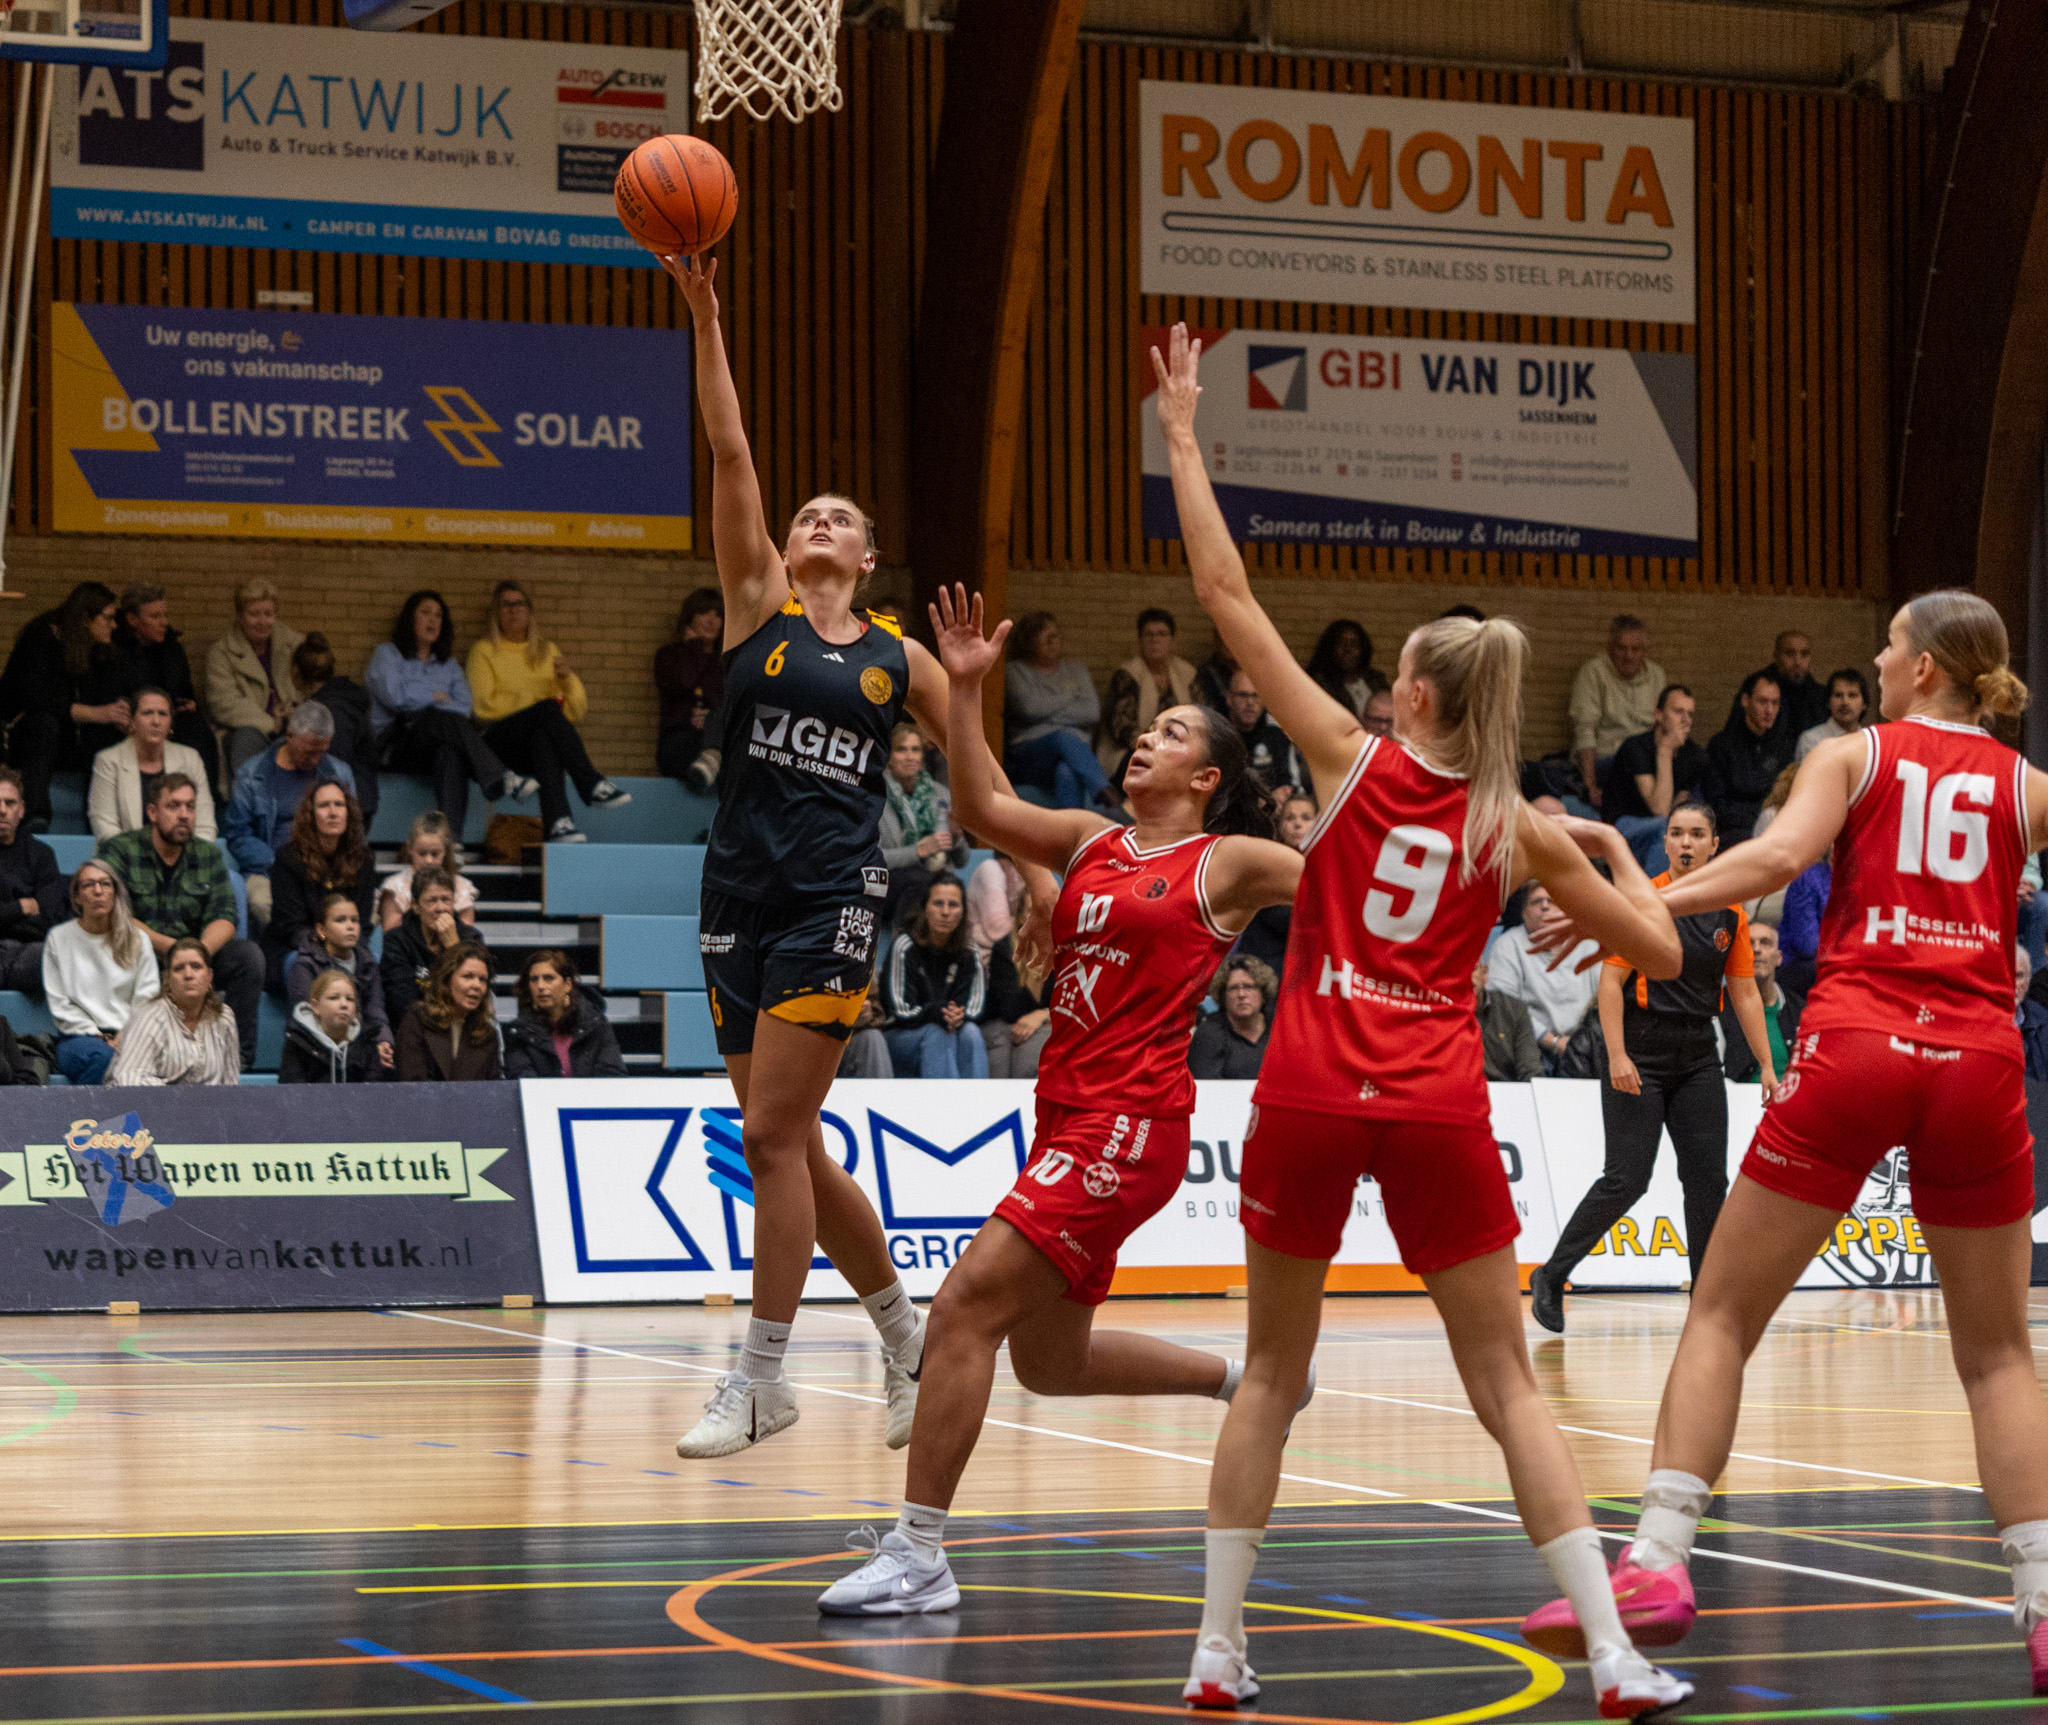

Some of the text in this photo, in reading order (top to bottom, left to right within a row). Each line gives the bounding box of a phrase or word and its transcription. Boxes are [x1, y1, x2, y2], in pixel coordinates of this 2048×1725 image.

[78, 66, 205, 123] ATS
[221, 70, 513, 140] KATWIJK
[595, 120, 663, 140] BOSCH
[221, 135, 263, 153] Auto
[268, 137, 281, 154] &
[287, 138, 337, 156] Truck
[343, 141, 408, 161] Service
[414, 146, 481, 167] Katwijk
[1160, 113, 1674, 229] ROMONTA
[77, 207, 268, 231] WWW.ATSKATWIJK.NL
[306, 218, 377, 238] CAMPER
[382, 222, 406, 238] EN
[411, 224, 488, 242] CARAVAN
[494, 226, 562, 247] BOVAG
[1160, 244, 1674, 293] FOOD CONVEYORS & STAINLESS STEEL PLATFORMS
[145, 325, 276, 354] Uw energie,
[184, 358, 384, 386] ons vakmanschap
[1319, 348, 1597, 407] GBI VAN DIJK
[102, 397, 644, 450] BOLLENSTREEK SOLAR
[1518, 409, 1598, 426] SASSENHEIM
[1249, 514, 1582, 548] Samen sterk in Bouw & Industrie
[764, 641, 790, 677] 6
[748, 743, 862, 787] VAN DIJK SASSENHEIM
[791, 716, 875, 775] GBI
[1896, 758, 1997, 883] 16
[1362, 823, 1454, 944] 9
[1076, 892, 1114, 934] 10
[1862, 905, 2000, 945] HESSELINK
[1906, 930, 1985, 951] MAATWERK
[44, 1150, 453, 1191] Het Wapen van Kattuk
[1026, 1148, 1075, 1186] 10
[44, 1238, 473, 1277] wapenvankattuk.nl
